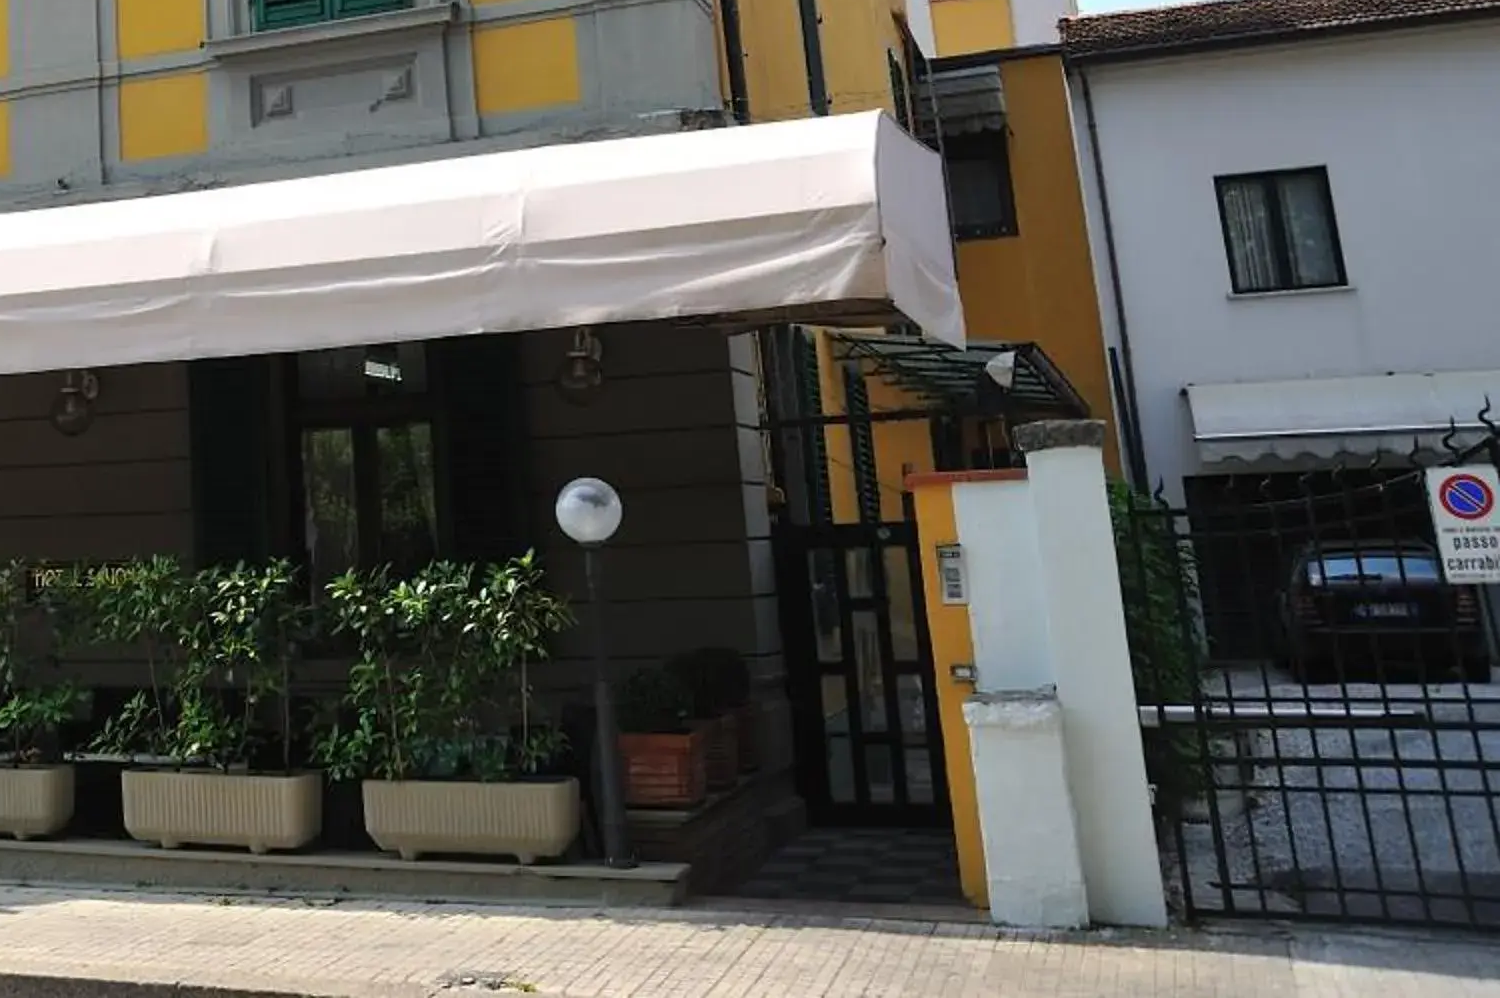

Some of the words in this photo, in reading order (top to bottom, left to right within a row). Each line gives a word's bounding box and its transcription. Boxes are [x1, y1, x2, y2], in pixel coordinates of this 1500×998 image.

[1453, 536, 1498, 551] passo
[1447, 555, 1500, 571] carrabi
[35, 568, 83, 588] HOTL
